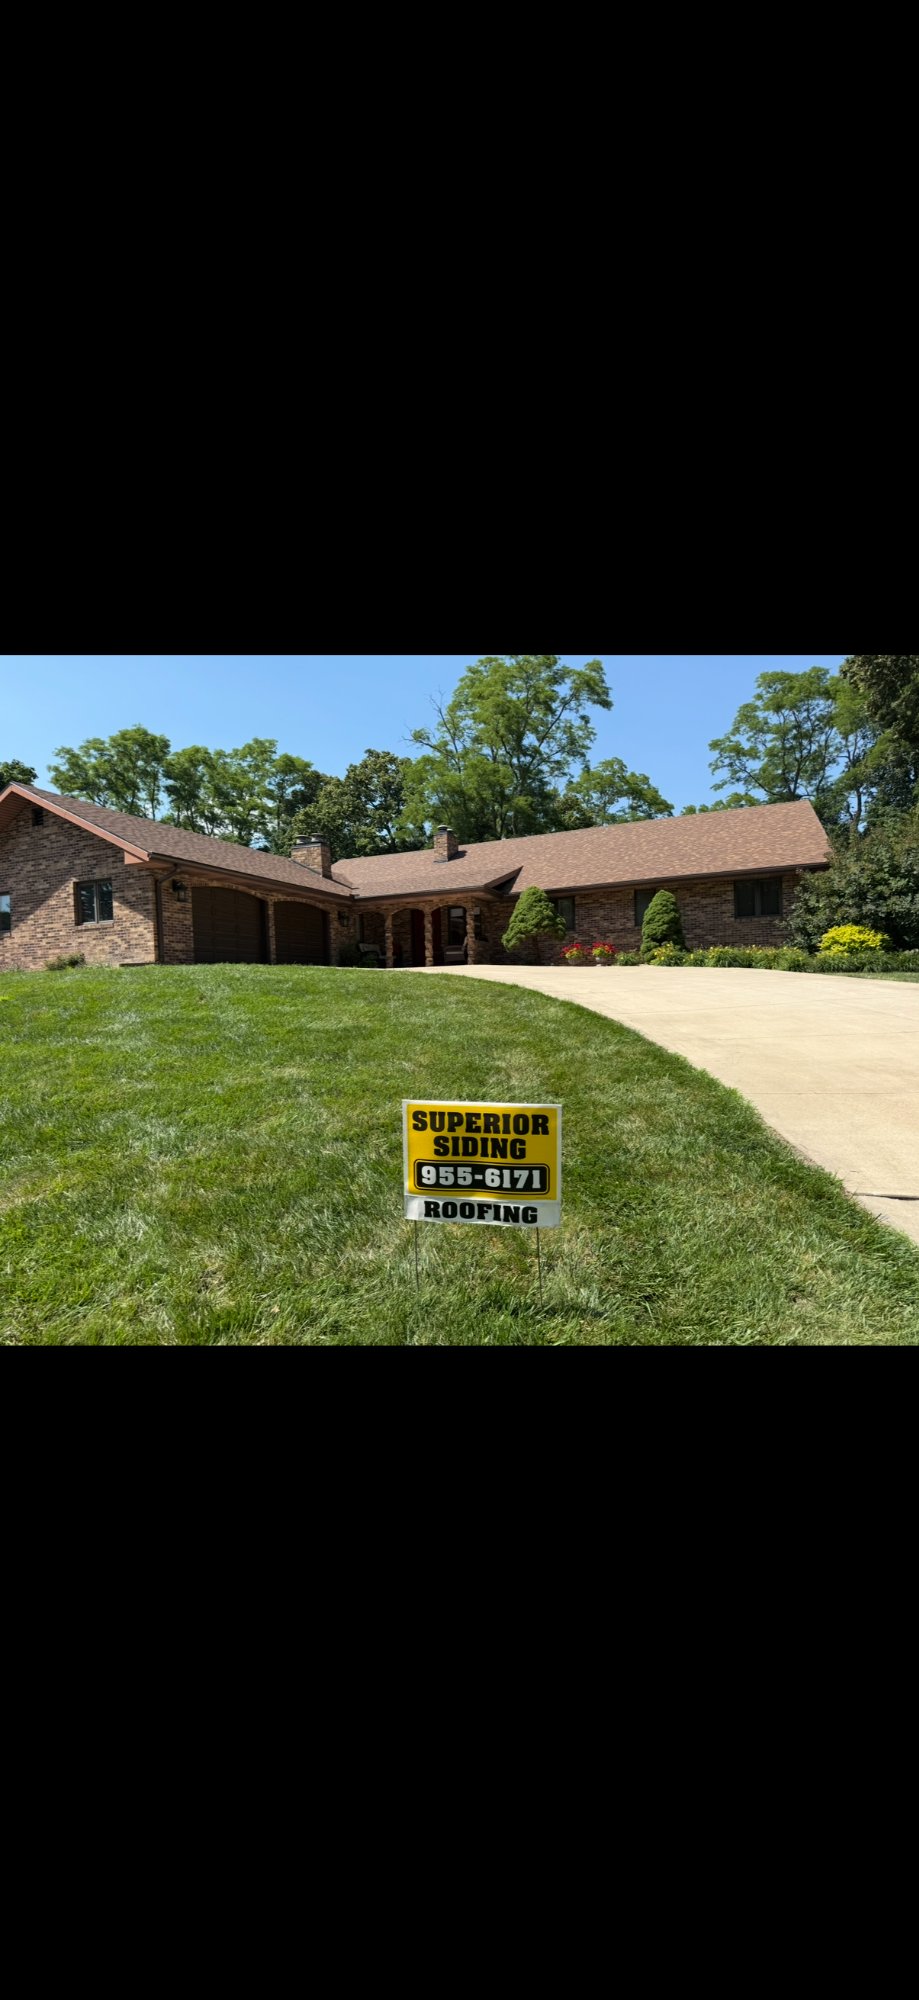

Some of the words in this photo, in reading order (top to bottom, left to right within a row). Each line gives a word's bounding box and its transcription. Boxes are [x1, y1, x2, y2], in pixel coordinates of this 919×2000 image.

[412, 1110, 550, 1135] SUPERIOR
[433, 1136, 527, 1160] SIDING
[421, 1165, 541, 1189] 955-6171
[424, 1200, 538, 1224] ROOFING
